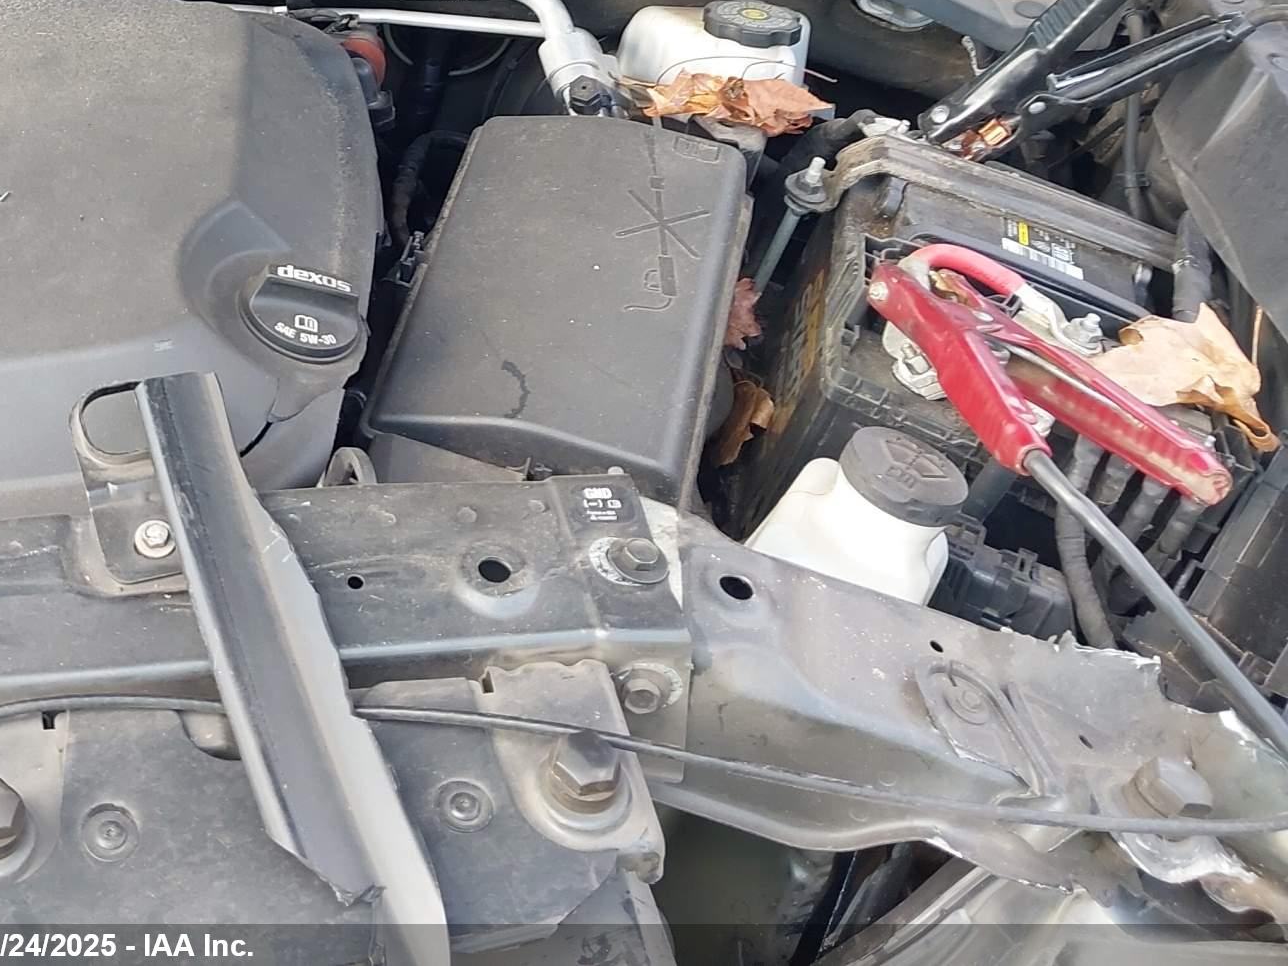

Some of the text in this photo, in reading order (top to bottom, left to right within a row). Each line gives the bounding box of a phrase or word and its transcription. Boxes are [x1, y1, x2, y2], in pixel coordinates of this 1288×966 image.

[276, 264, 353, 293] dexos
[274, 322, 337, 345] SAE 5W-30
